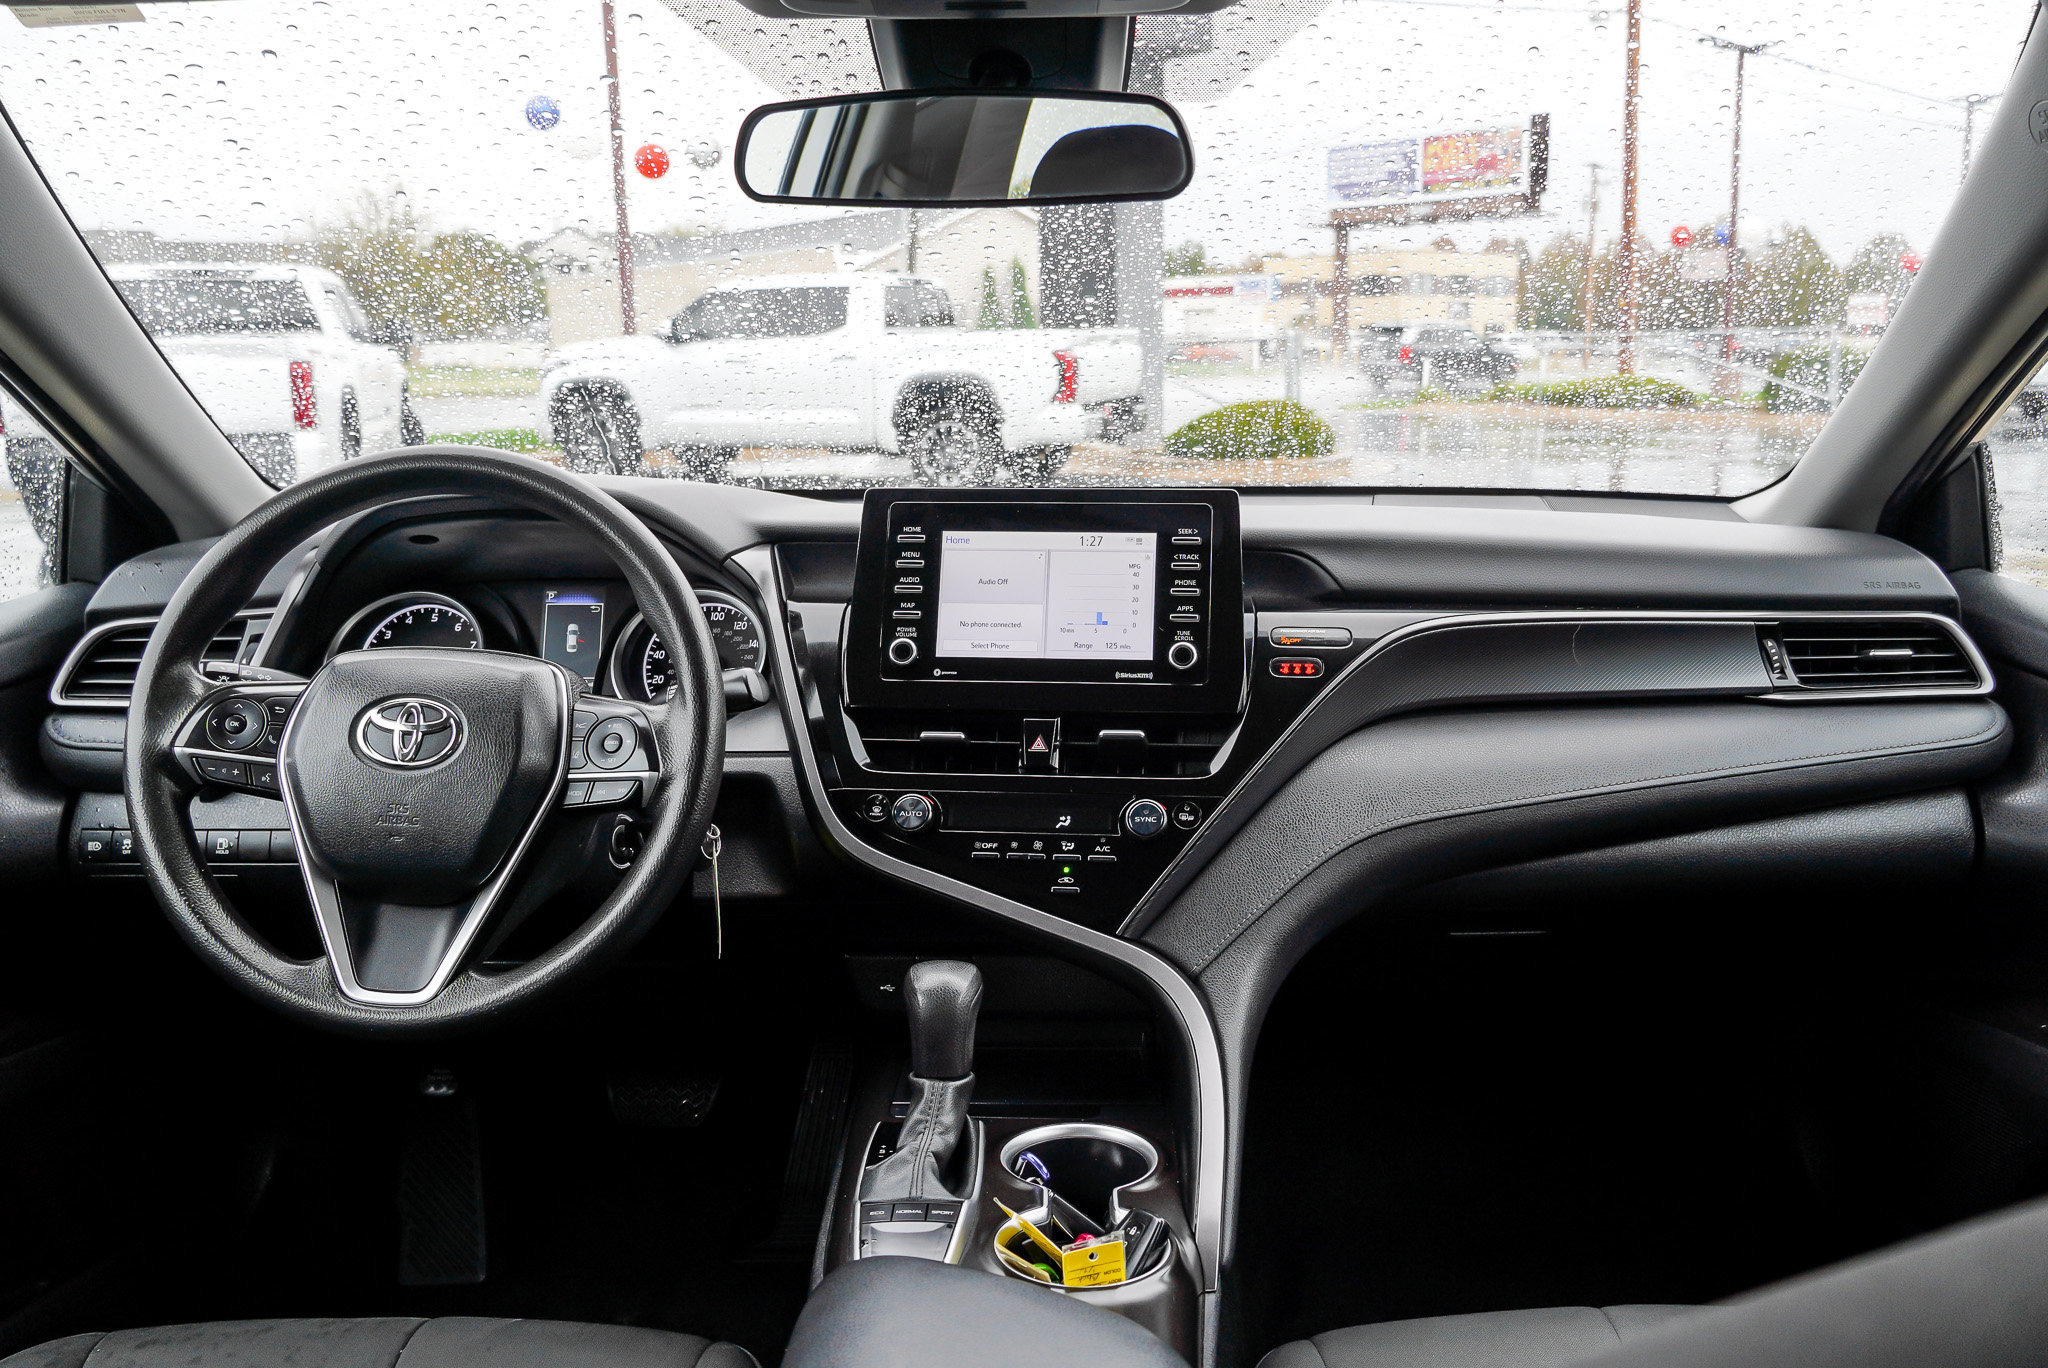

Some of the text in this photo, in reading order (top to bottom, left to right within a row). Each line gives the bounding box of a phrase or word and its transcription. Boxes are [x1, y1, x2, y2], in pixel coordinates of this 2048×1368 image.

[945, 535, 971, 545] Home
[1079, 535, 1104, 547] 1:27
[1863, 581, 1921, 589] SRS AIRBAG
[405, 616, 413, 625] 4
[430, 613, 438, 623] 5
[710, 611, 725, 621] 100
[454, 622, 462, 632] 6
[733, 621, 748, 630] 120
[959, 620, 969, 628] No
[970, 620, 989, 630] phone
[383, 630, 392, 640] 3
[470, 641, 477, 649] 7
[971, 641, 1010, 650] Select Phone
[1074, 642, 1093, 650] Range
[1105, 642, 1118, 650] 125
[653, 650, 666, 660] 40
[652, 674, 665, 684] 20
[1094, 845, 1111, 853] A/C
